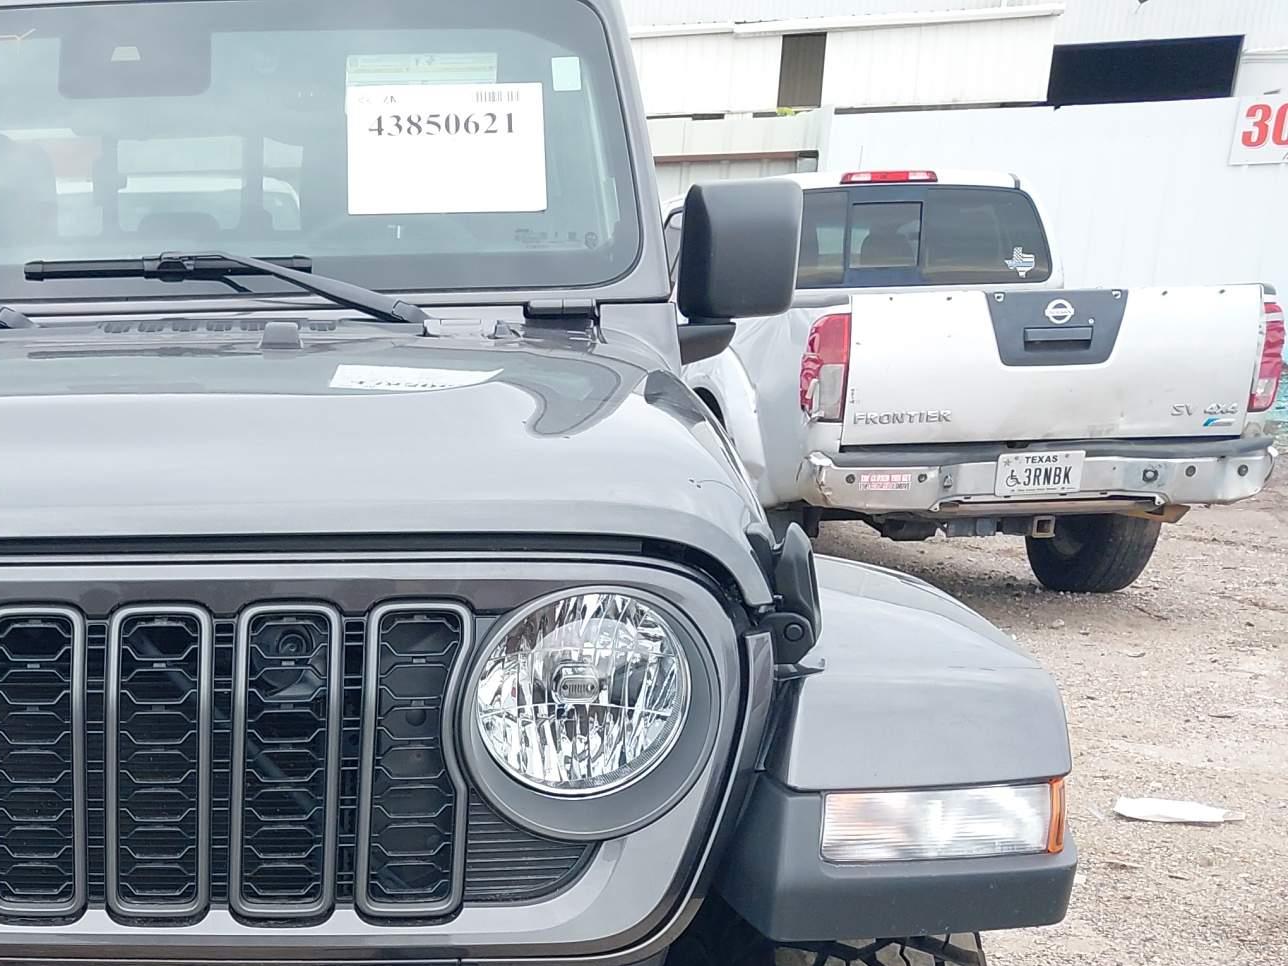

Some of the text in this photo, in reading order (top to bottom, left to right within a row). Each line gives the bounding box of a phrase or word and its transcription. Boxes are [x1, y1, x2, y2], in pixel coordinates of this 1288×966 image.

[368, 112, 514, 137] 43850621
[853, 409, 952, 425] FRONTIER
[1025, 455, 1058, 464] TEXAS
[1023, 466, 1073, 487] 3RNBK
